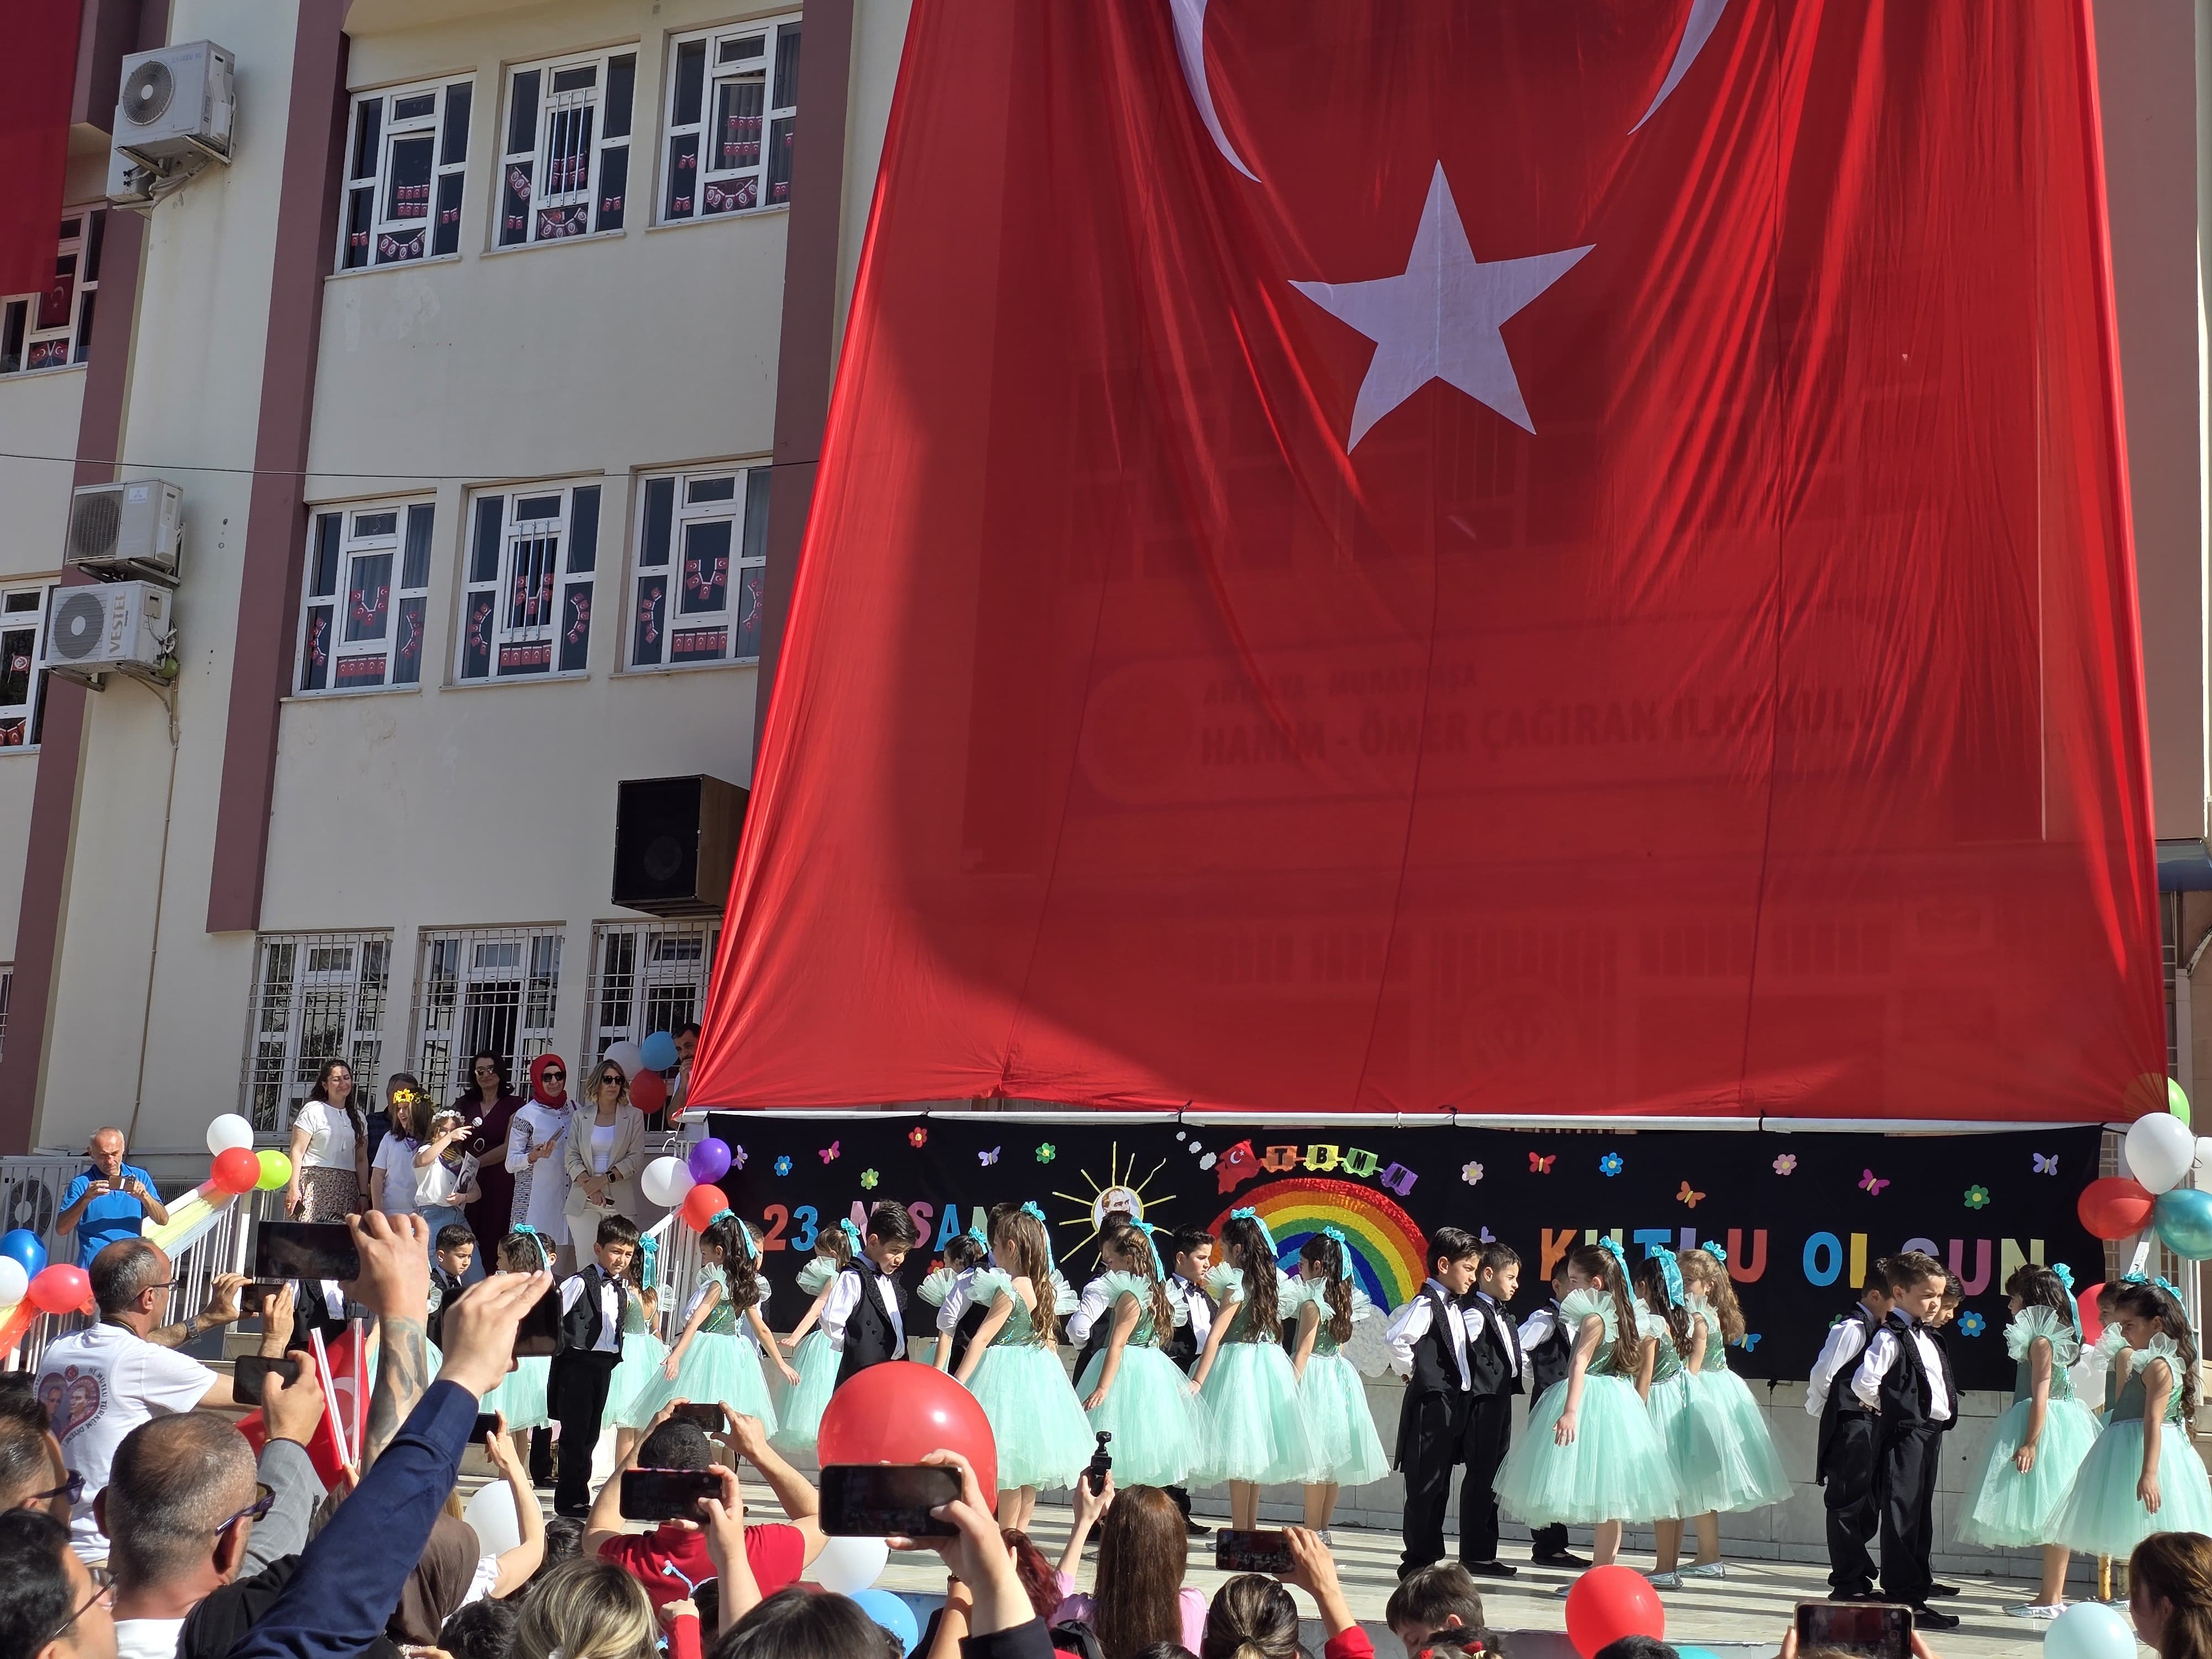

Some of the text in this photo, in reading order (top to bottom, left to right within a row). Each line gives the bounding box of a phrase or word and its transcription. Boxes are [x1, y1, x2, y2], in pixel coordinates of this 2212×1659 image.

[109, 591, 126, 654] VESTEL
[1359, 708, 1469, 757] ÖMER
[1480, 698, 1658, 762] ÇAĞIRAN
[763, 1204, 818, 1252] 23
[851, 1201, 996, 1252] NSA
[96, 1372, 108, 1397] MUTLU
